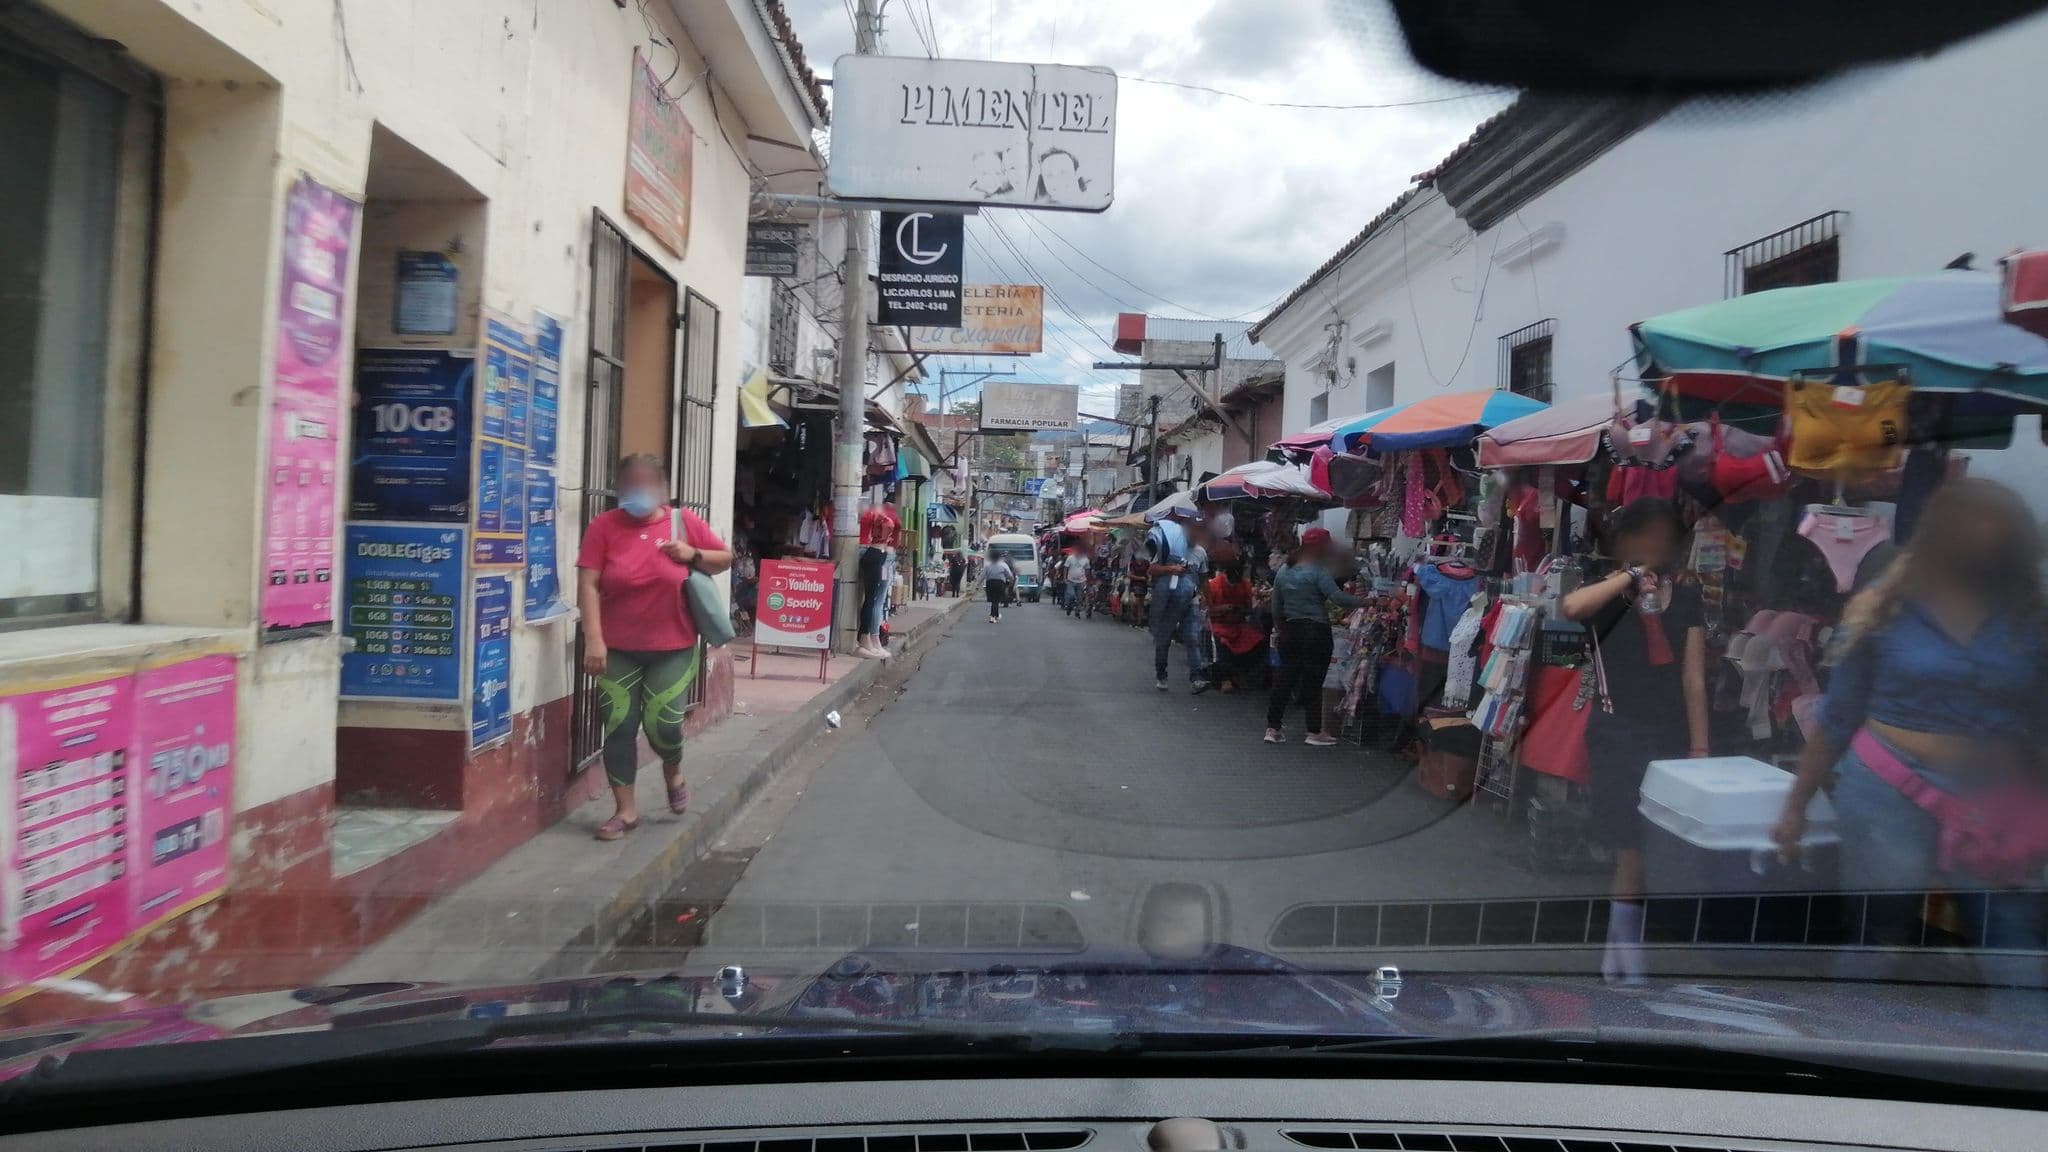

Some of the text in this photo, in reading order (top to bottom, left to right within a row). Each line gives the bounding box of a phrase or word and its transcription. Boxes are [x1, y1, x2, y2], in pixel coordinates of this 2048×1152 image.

[900, 83, 1109, 133] PIMENTEL
[881, 273, 959, 284] DESPACHO JURIDICO
[934, 289, 956, 298] LIMA
[370, 402, 456, 433] 10GB
[990, 418, 1069, 428] FARMACIA POPULAR
[788, 578, 825, 593] YouTube
[368, 594, 387, 603] 3GB
[786, 598, 823, 611] Spotify
